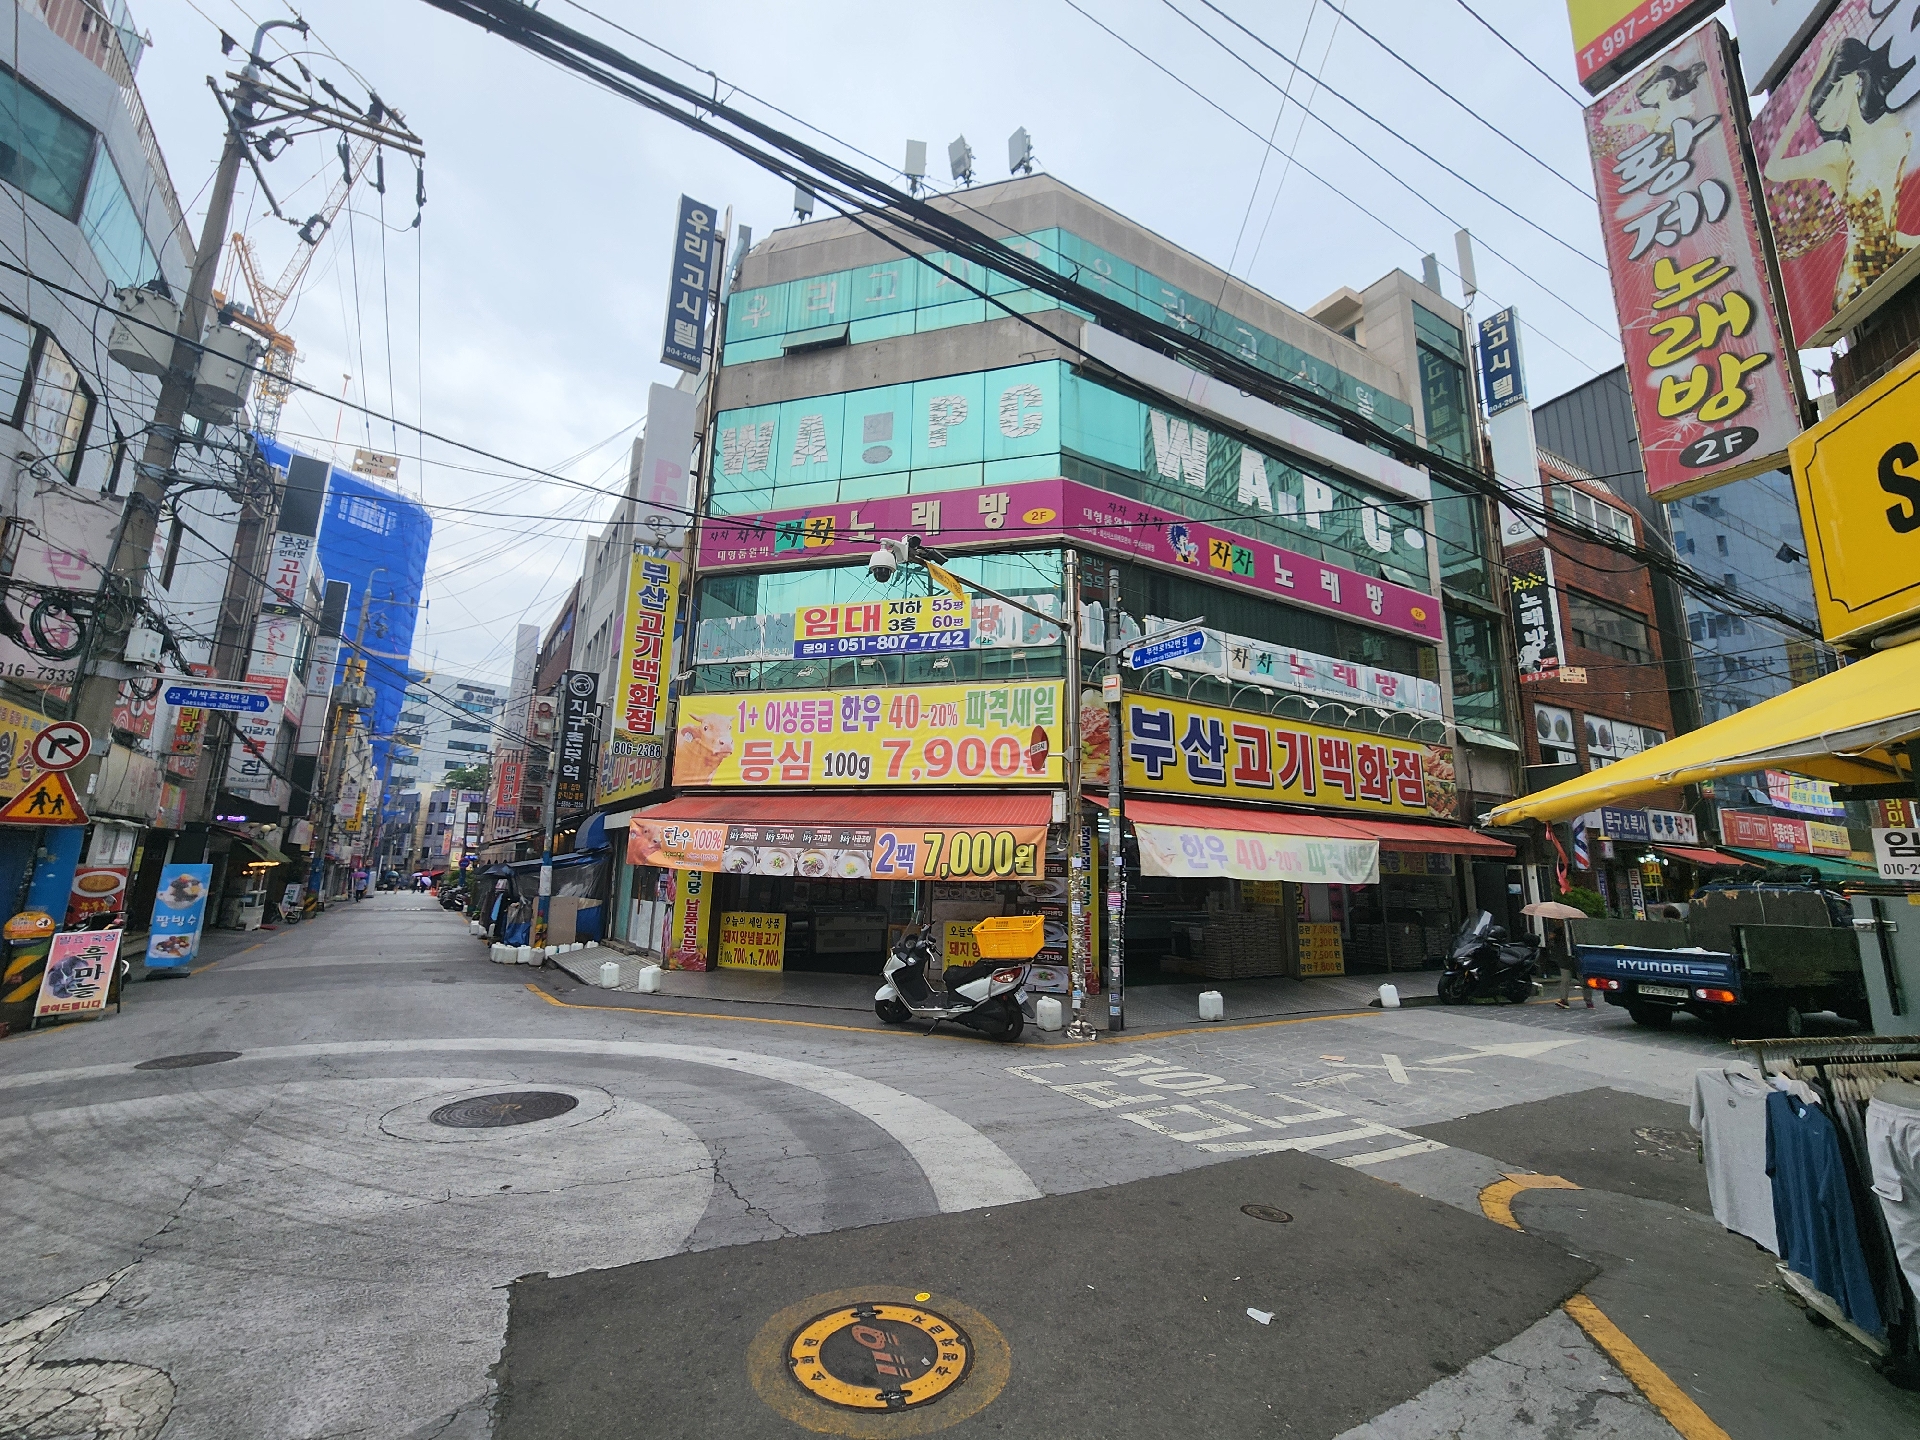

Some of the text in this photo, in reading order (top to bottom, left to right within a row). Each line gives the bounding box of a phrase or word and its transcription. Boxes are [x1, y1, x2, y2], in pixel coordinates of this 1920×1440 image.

[1612, 115, 1730, 261] 황제
[674, 209, 710, 350] 우리고시텔
[1482, 310, 1509, 332] 우리
[1648, 256, 1771, 422] 노래방
[666, 346, 701, 363] 804-2662
[1487, 325, 1514, 400] 고시텔
[1694, 432, 1743, 465] 2F
[849, 492, 1011, 544] 노래방
[1031, 511, 1047, 521] 2F
[275, 559, 301, 603] 고시텔
[1273, 553, 1385, 617] 노래방
[803, 597, 964, 638] 임대 지하 55평
[888, 614, 964, 632] 3층 60평
[1520, 592, 1549, 649] 노래방
[625, 561, 670, 734] 부산고기백화점
[802, 640, 826, 654] 문의
[838, 630, 964, 653] 051-807-7742
[1231, 647, 1273, 674] 차차
[1289, 653, 1399, 697] 노래방
[169, 692, 181, 700] 22
[188, 689, 250, 704] 새싹로28번길
[255, 700, 265, 708] 18
[738, 704, 759, 734] 1+
[765, 700, 835, 734] 이상등급
[841, 695, 881, 732] 한우
[965, 686, 1055, 728] 파격세일
[241, 725, 276, 737] 자갈치
[613, 742, 663, 758] 806-2388
[740, 740, 812, 782] 등심
[824, 752, 871, 779] 100g
[1129, 706, 1427, 809] 부산고기백화점
[664, 826, 722, 850] 한우 100%
[875, 831, 1038, 880] 2팩 7,000원
[1178, 832, 1229, 870] 한우
[156, 914, 197, 928] 팥빙수
[680, 898, 701, 954] 납품전문
[724, 916, 780, 929] 오늘의 세일 상품
[67, 944, 109, 999] 흑마늘
[1616, 959, 1690, 975] HYUNDAI
